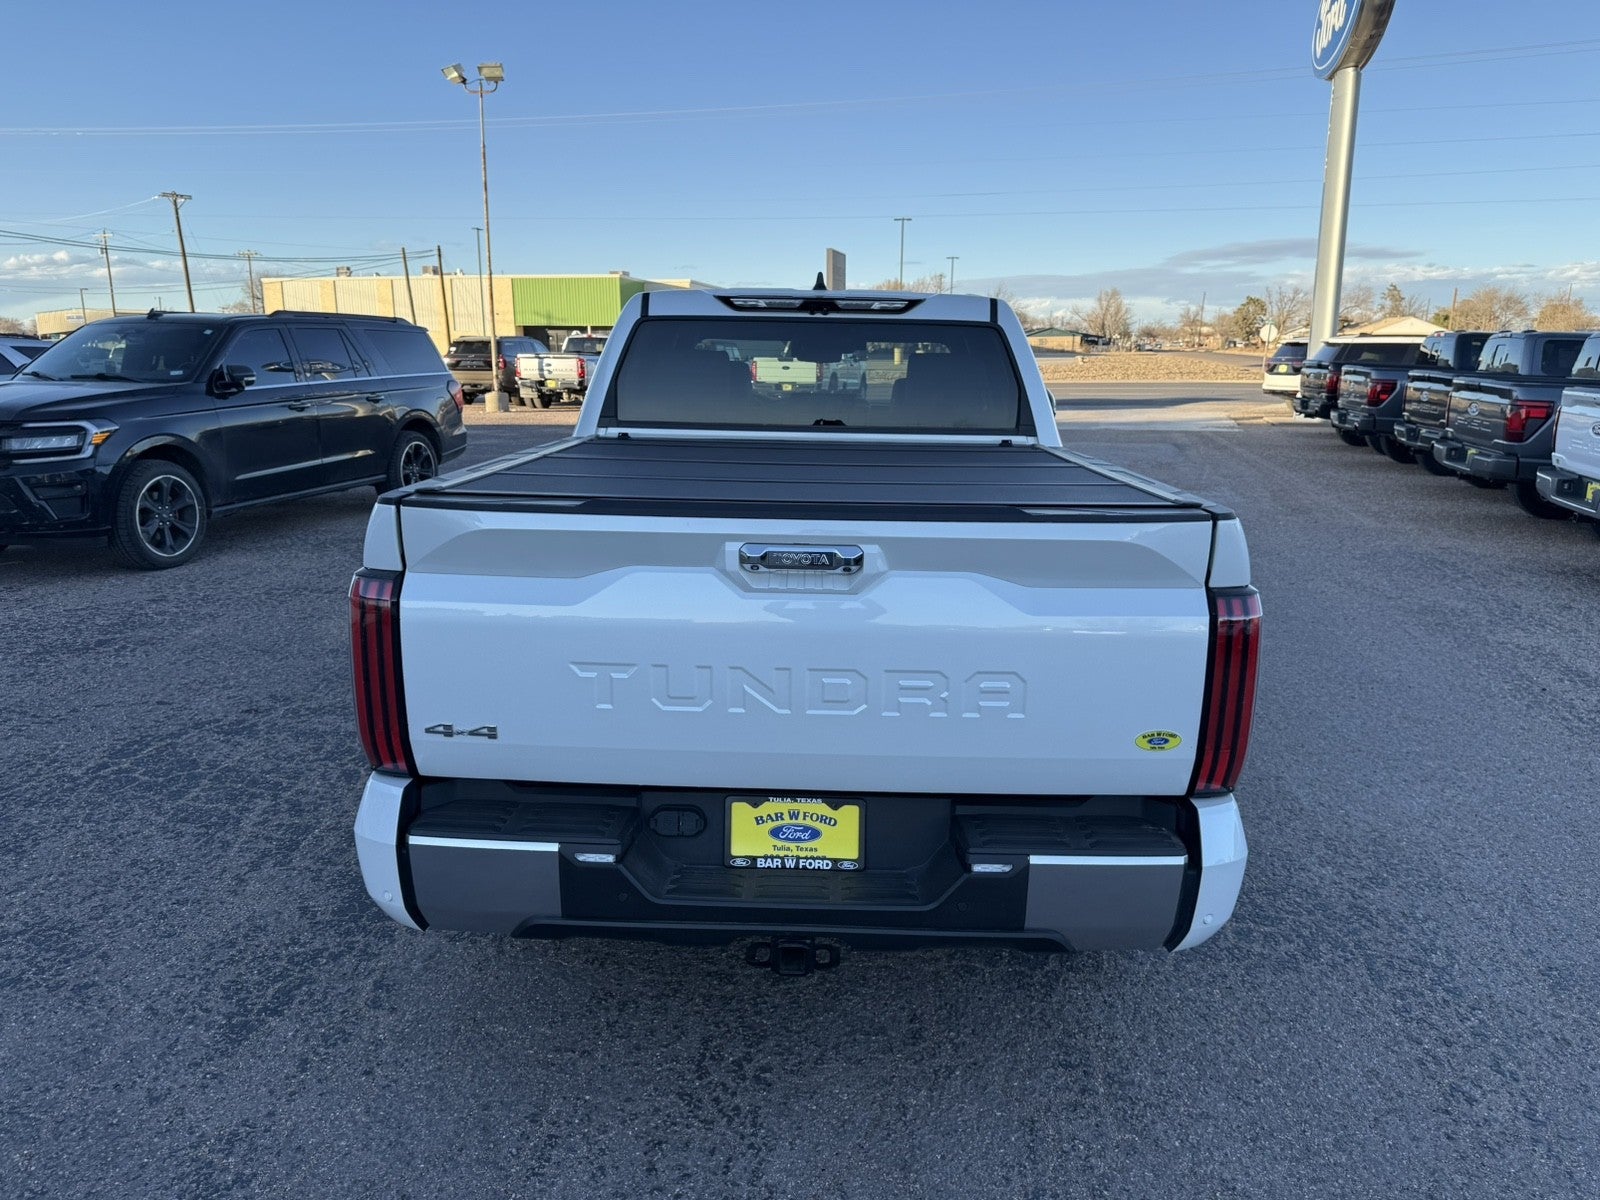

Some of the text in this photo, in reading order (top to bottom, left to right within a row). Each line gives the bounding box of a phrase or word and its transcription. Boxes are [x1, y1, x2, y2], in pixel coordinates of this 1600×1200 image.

[773, 553, 829, 565] TOYOTA
[569, 661, 1028, 719] TUNDRA
[754, 809, 838, 827] BAR W FORD
[779, 826, 812, 839] Ford
[757, 857, 832, 870] BAR W FORD
